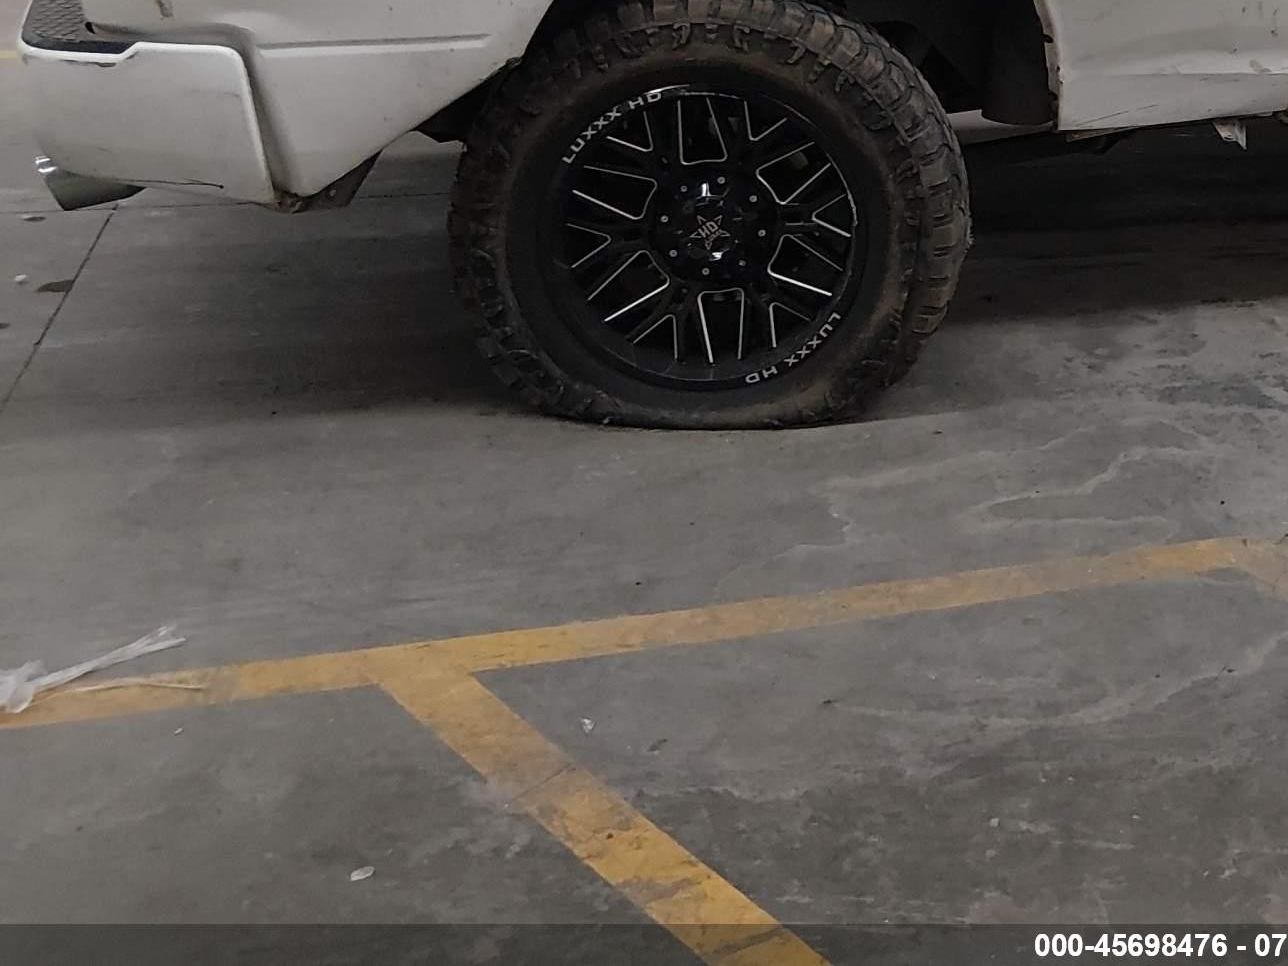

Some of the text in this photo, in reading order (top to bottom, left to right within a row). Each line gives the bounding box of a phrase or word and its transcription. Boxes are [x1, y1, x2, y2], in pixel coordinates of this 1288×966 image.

[562, 92, 662, 164] LUXXX HD
[698, 221, 719, 238] HD
[745, 313, 841, 383] LUXXX HD
